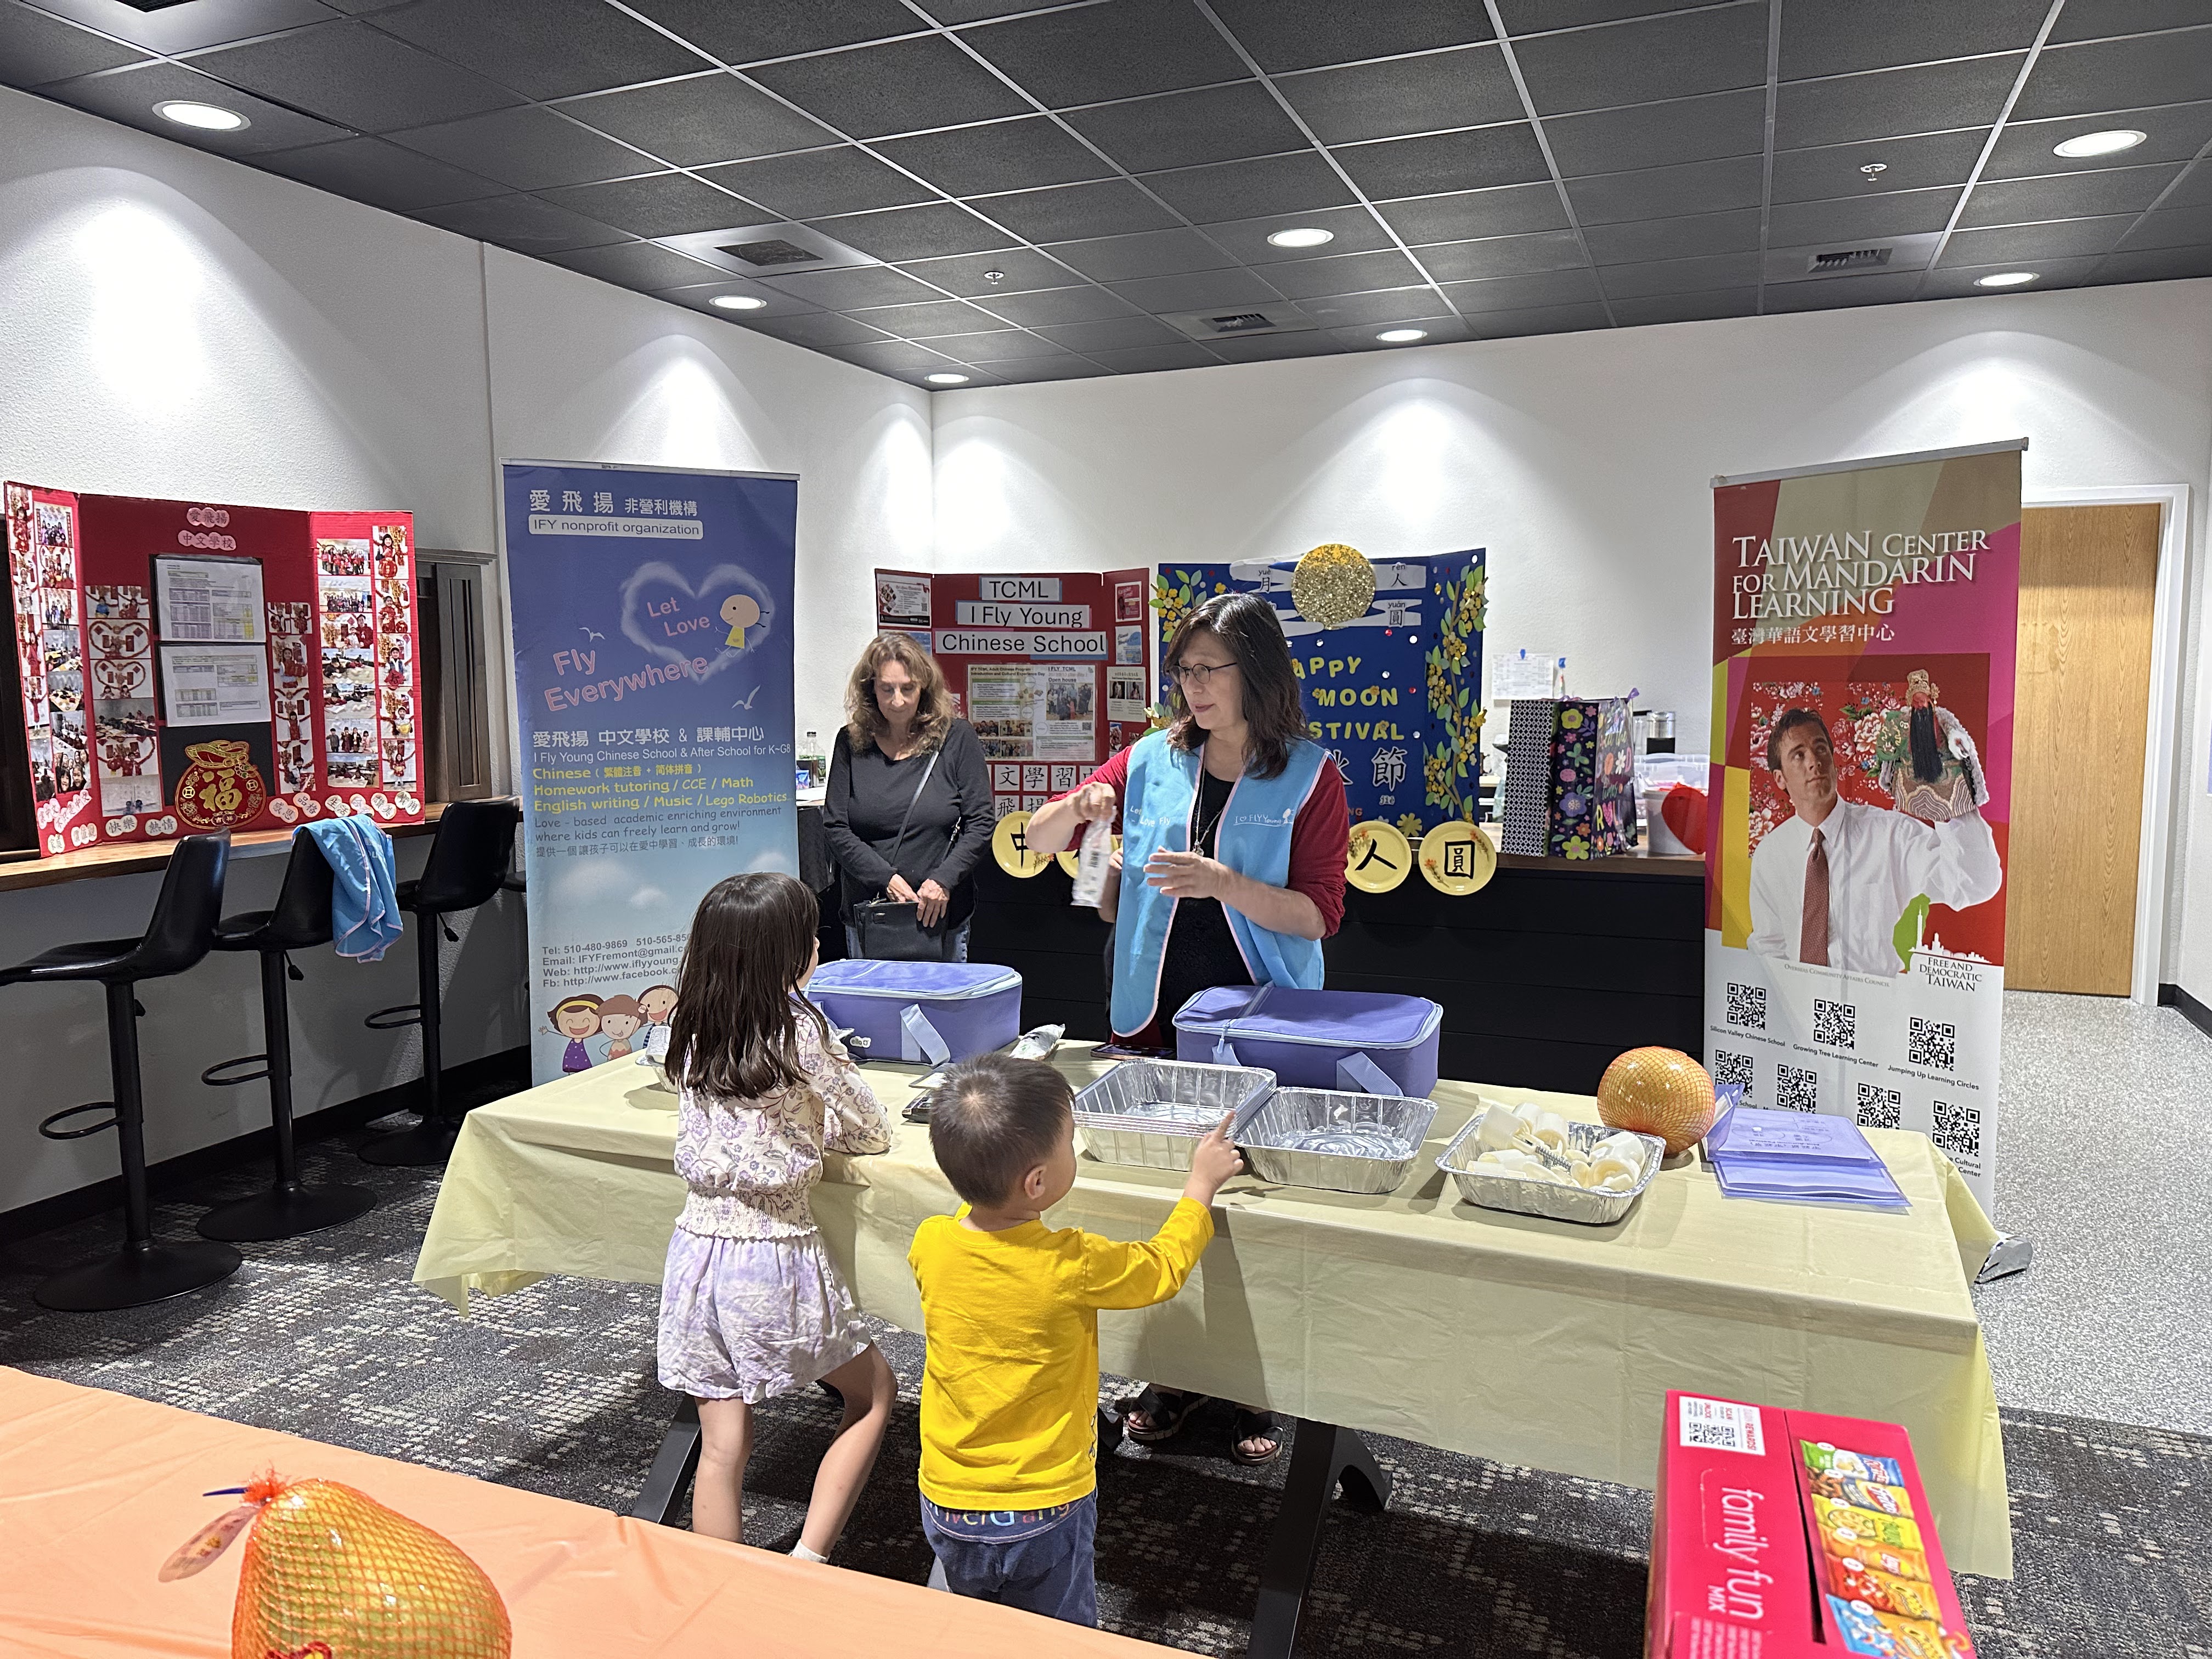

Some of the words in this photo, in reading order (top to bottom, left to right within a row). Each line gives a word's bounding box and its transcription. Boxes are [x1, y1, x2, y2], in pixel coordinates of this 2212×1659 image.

[625, 497, 697, 516] 非營利機構
[534, 519, 557, 530] IFY
[562, 521, 619, 533] nonprofit
[623, 523, 699, 535] organization
[183, 533, 234, 549] 中文學校
[1733, 531, 1871, 568] TAIWAN
[1391, 573, 1407, 587] 人
[1782, 552, 1976, 591] MANDARIN
[989, 581, 1048, 598] TCML
[1260, 577, 1269, 592] 月
[646, 596, 680, 618] Let
[1732, 588, 1895, 620] LEARNING
[663, 614, 710, 637] Love
[972, 606, 975, 623] I
[983, 606, 1012, 627] Fly
[1019, 607, 1083, 629] Young
[1390, 610, 1402, 626] 圓
[943, 635, 1025, 652] Chinese
[1034, 635, 1105, 652] School
[1731, 624, 1895, 646] 臺灣華語文學習中心
[552, 648, 596, 676] Fly
[544, 657, 709, 712] Everywhere
[1318, 687, 1398, 707] MOON
[533, 731, 589, 747] 愛飛揚
[599, 727, 669, 746] 中文學校
[679, 728, 687, 742] &
[697, 726, 764, 743] 課輔中心
[534, 752, 537, 762] I
[541, 752, 556, 765] Fly
[560, 752, 594, 764] Young
[597, 750, 639, 761] Chinese
[642, 748, 676, 759] School
[680, 748, 688, 758] &
[690, 747, 714, 757] After
[717, 746, 751, 756] School
[754, 745, 766, 755] for
[533, 768, 591, 780] Chinese
[199, 769, 242, 812] 福
[534, 782, 610, 796] Homework
[614, 780, 670, 793] tutoring
[682, 778, 707, 790] CCE
[722, 777, 753, 789] Math
[534, 799, 586, 814] English
[592, 797, 640, 810] writing
[654, 795, 692, 807] Music
[706, 795, 735, 808] Lego
[535, 817, 561, 828] Love
[574, 816, 607, 826] based
[614, 813, 664, 824] academic
[668, 810, 716, 821] enriching
[720, 806, 781, 818] environment
[1140, 815, 1155, 827] Love
[1159, 816, 1171, 826] Fly
[535, 831, 571, 842] where
[575, 830, 597, 840] kids
[601, 830, 619, 838] can
[623, 825, 657, 838] freely
[661, 825, 687, 834] learn
[691, 822, 709, 832] and
[712, 821, 740, 834] grow!
[1355, 839, 1397, 871] 人
[1444, 840, 1475, 880] 圓
[542, 946, 560, 955] Tel:
[564, 940, 628, 954] 510-480-9869
[543, 957, 575, 966] Email:
[1928, 957, 1949, 967] FREE
[1950, 961, 1973, 972] AND
[543, 968, 571, 977] Web:
[1920, 964, 1982, 982] DEMOCRATIC
[543, 979, 560, 988] Fb:
[1926, 973, 1975, 992] TAIWAN
[1710, 1025, 1726, 1034] Silicon
[1728, 1029, 1744, 1039] Valley
[1745, 1032, 1767, 1042] Chinese
[1768, 1037, 1785, 1047] School
[1793, 1044, 1818, 1055] Growing
[1832, 1052, 1857, 1064] Learning
[1859, 1058, 1878, 1068] Center
[1888, 1065, 1915, 1077] Jumping
[1917, 1070, 1926, 1079] Up
[1928, 1073, 1955, 1086] Learning
[1957, 1080, 1979, 1091] Circles
[1739, 1100, 1757, 1109] School
[1955, 1157, 1981, 1169] Cultural
[1959, 1167, 1981, 1177] Center
[1713, 1487, 1769, 1564] family
[1708, 1585, 1726, 1613] MIX
[1726, 1567, 1774, 1619] fun
